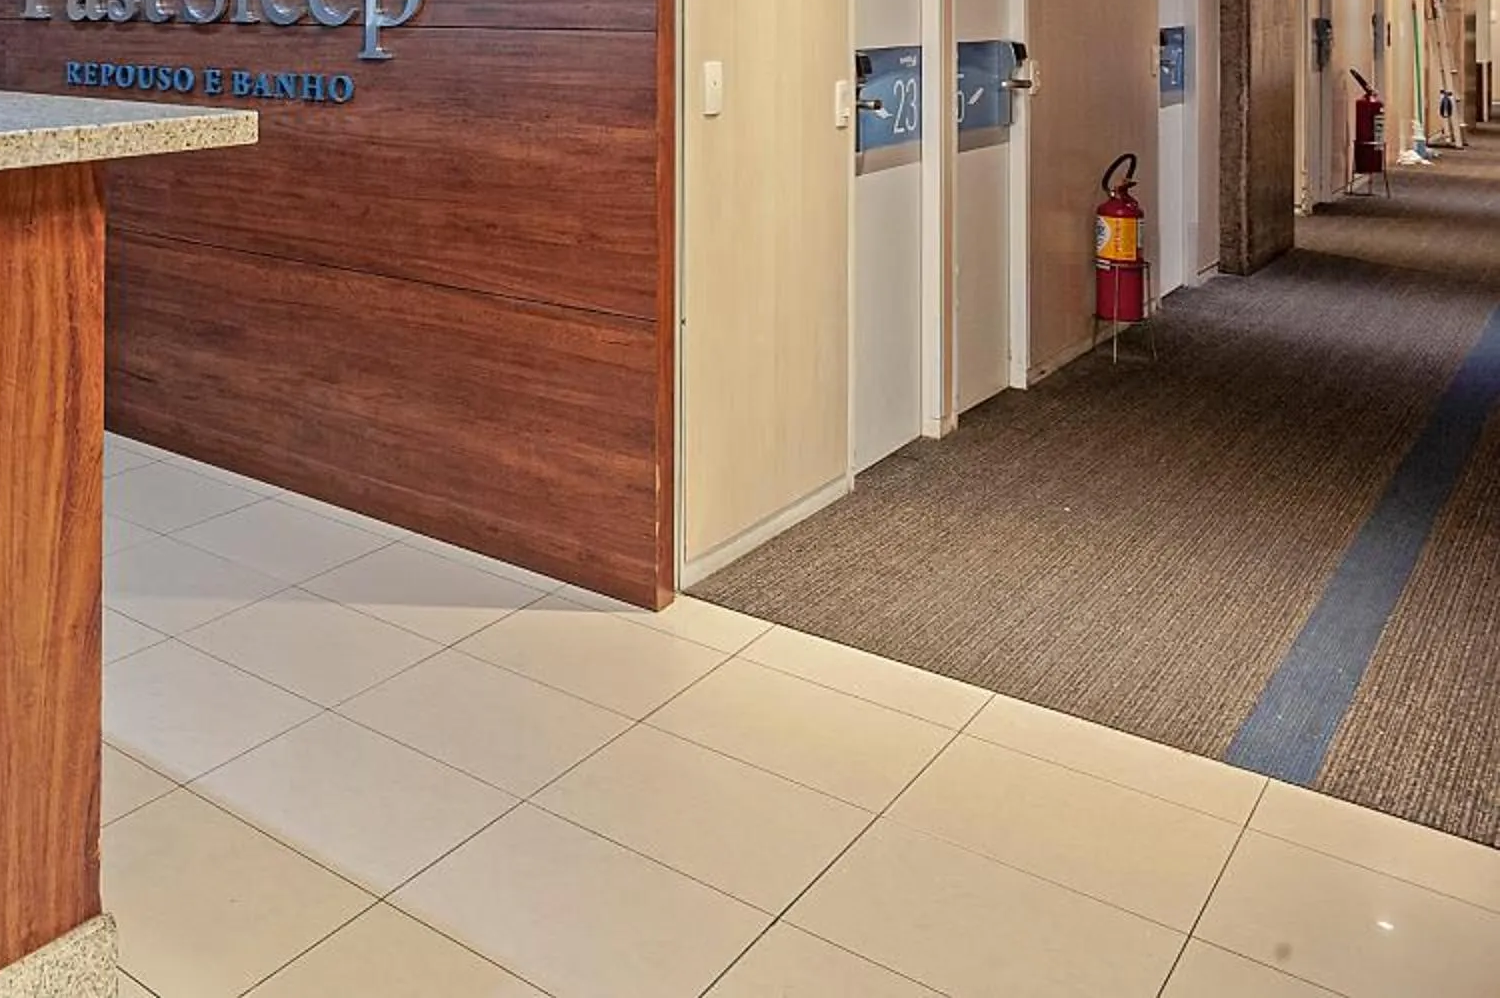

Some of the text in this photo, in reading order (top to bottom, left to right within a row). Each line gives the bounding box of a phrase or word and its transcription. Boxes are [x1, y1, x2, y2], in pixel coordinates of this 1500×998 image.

[66, 60, 355, 103] REPOUSO E BANHO
[893, 77, 918, 134] 23
